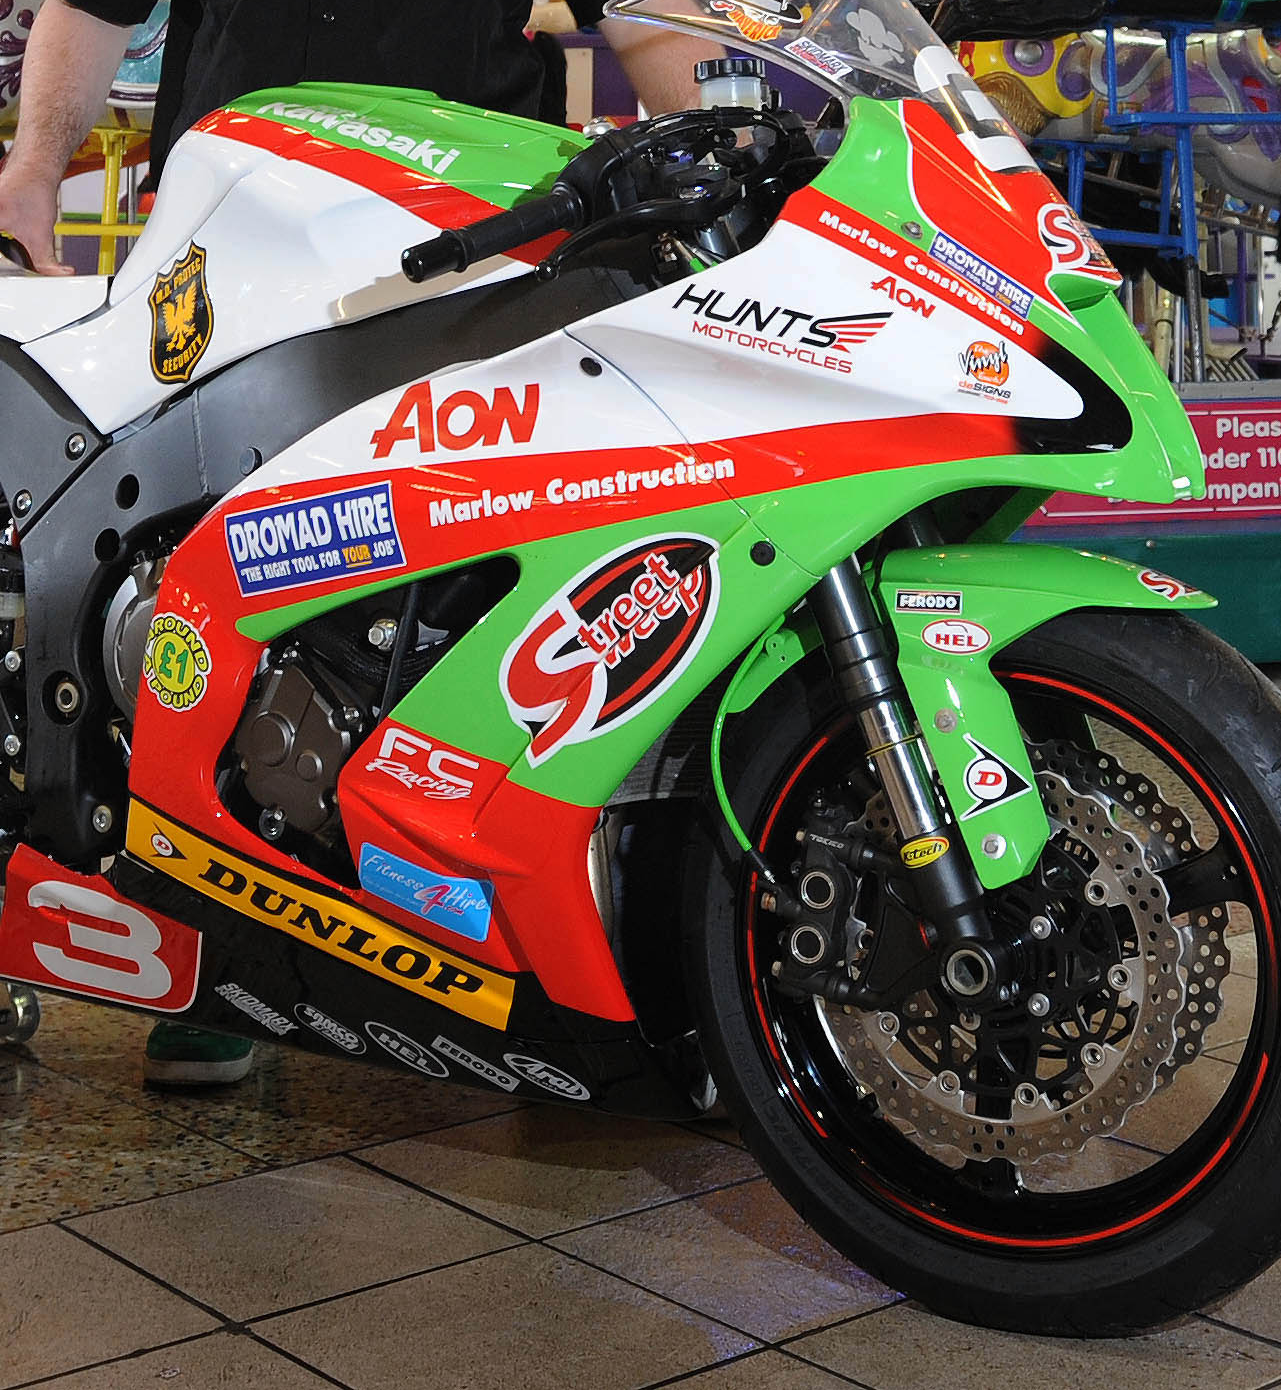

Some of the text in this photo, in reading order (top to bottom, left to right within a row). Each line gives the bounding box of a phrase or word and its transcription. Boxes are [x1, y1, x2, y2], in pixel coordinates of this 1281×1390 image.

[256, 102, 461, 175] Kawasaki
[818, 210, 1025, 336] Marlow Construction
[935, 235, 1033, 309] DROMAD HIRE
[672, 283, 894, 348] HUNTS
[871, 275, 936, 319] AON
[163, 332, 203, 373] SECURITY
[692, 321, 853, 374] MOTORCYCLES
[370, 380, 540, 459] AON
[429, 456, 735, 527] Marlow Construction
[229, 493, 392, 563] DROMAD HIRE
[263, 560, 291, 579] RIGHT
[291, 555, 319, 575] TOOL
[319, 549, 341, 568] FOR
[342, 544, 372, 567] YOUR
[899, 592, 957, 610] FERODO
[145, 616, 209, 673] AROUND
[159, 641, 189, 684] £1
[935, 632, 980, 649] HEL
[150, 674, 205, 709] POUND
[365, 758, 471, 800] Racing
[973, 770, 1003, 788] D
[27, 881, 172, 1000] 3
[198, 858, 484, 996] DUNLOP
[438, 1040, 512, 1086] FERODO
[519, 1062, 582, 1095] Arai
